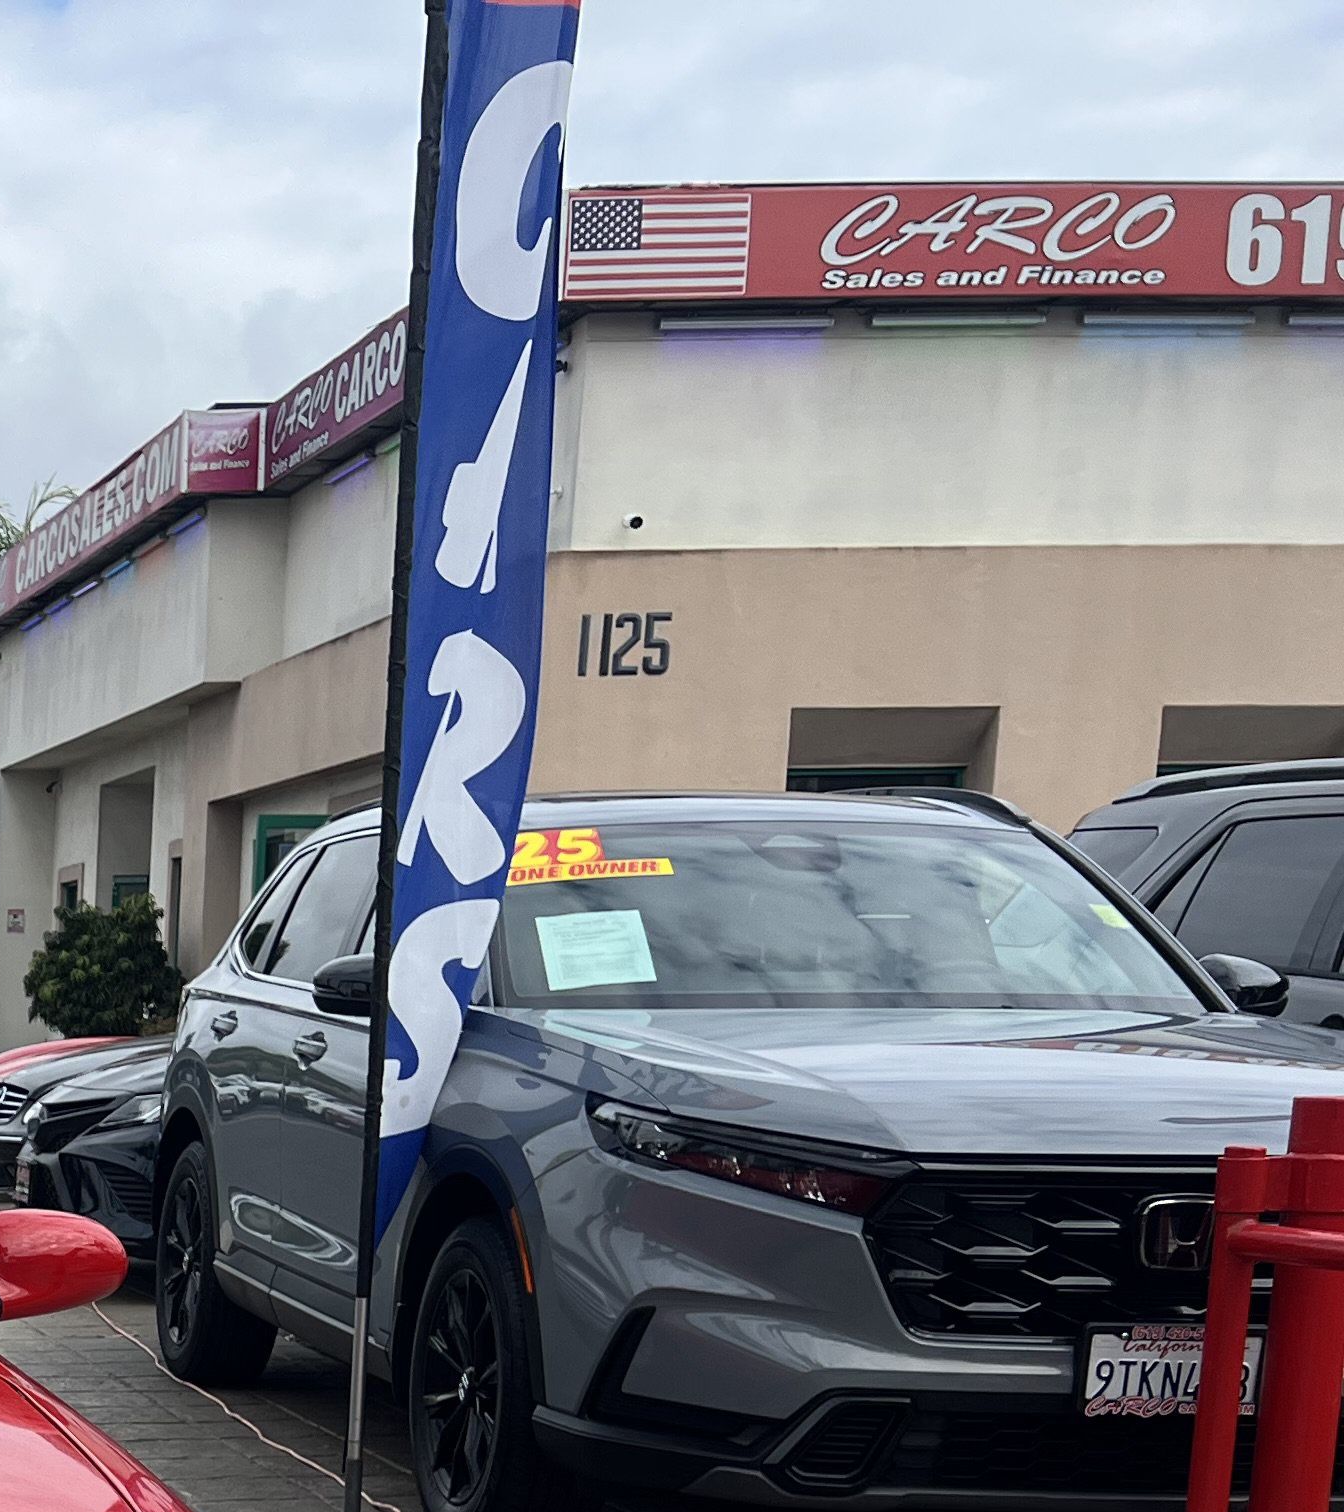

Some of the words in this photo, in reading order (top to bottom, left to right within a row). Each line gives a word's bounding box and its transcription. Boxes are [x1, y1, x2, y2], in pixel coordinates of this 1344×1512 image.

[820, 191, 1176, 265] CARCO
[1225, 192, 1344, 286] 61
[821, 268, 925, 289] Sales
[935, 266, 1008, 287] and
[1016, 265, 1166, 286] Finance
[271, 368, 334, 454] CARCO
[15, 424, 180, 594] CARCOSALES.COM
[577, 611, 673, 677] 1125
[511, 866, 559, 883] ONE
[568, 860, 658, 878] OWNER
[1123, 1340, 1204, 1358] Californ
[1092, 1359, 1251, 1402] 9TKN4
